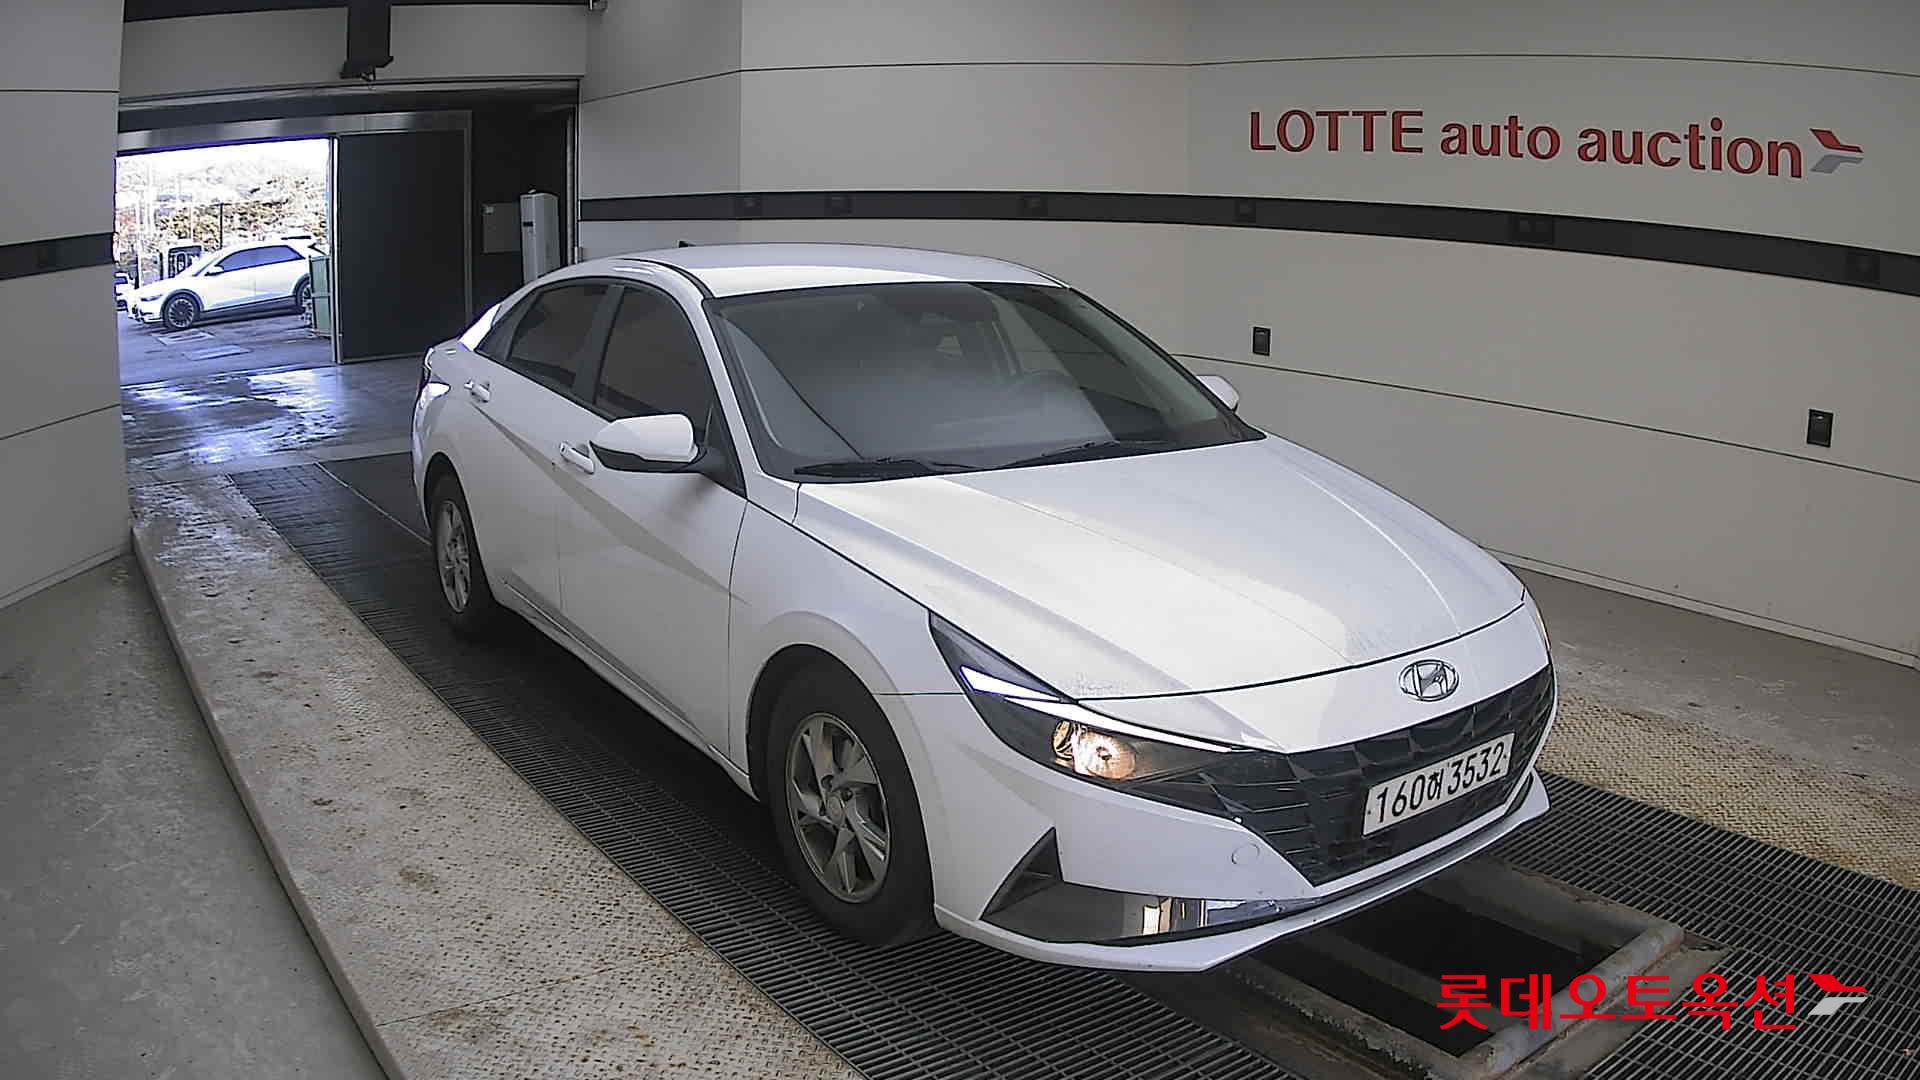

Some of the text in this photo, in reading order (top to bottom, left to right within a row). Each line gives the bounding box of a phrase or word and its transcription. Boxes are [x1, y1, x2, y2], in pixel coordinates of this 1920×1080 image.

[1250, 110, 1803, 178] LOTTE auto auction
